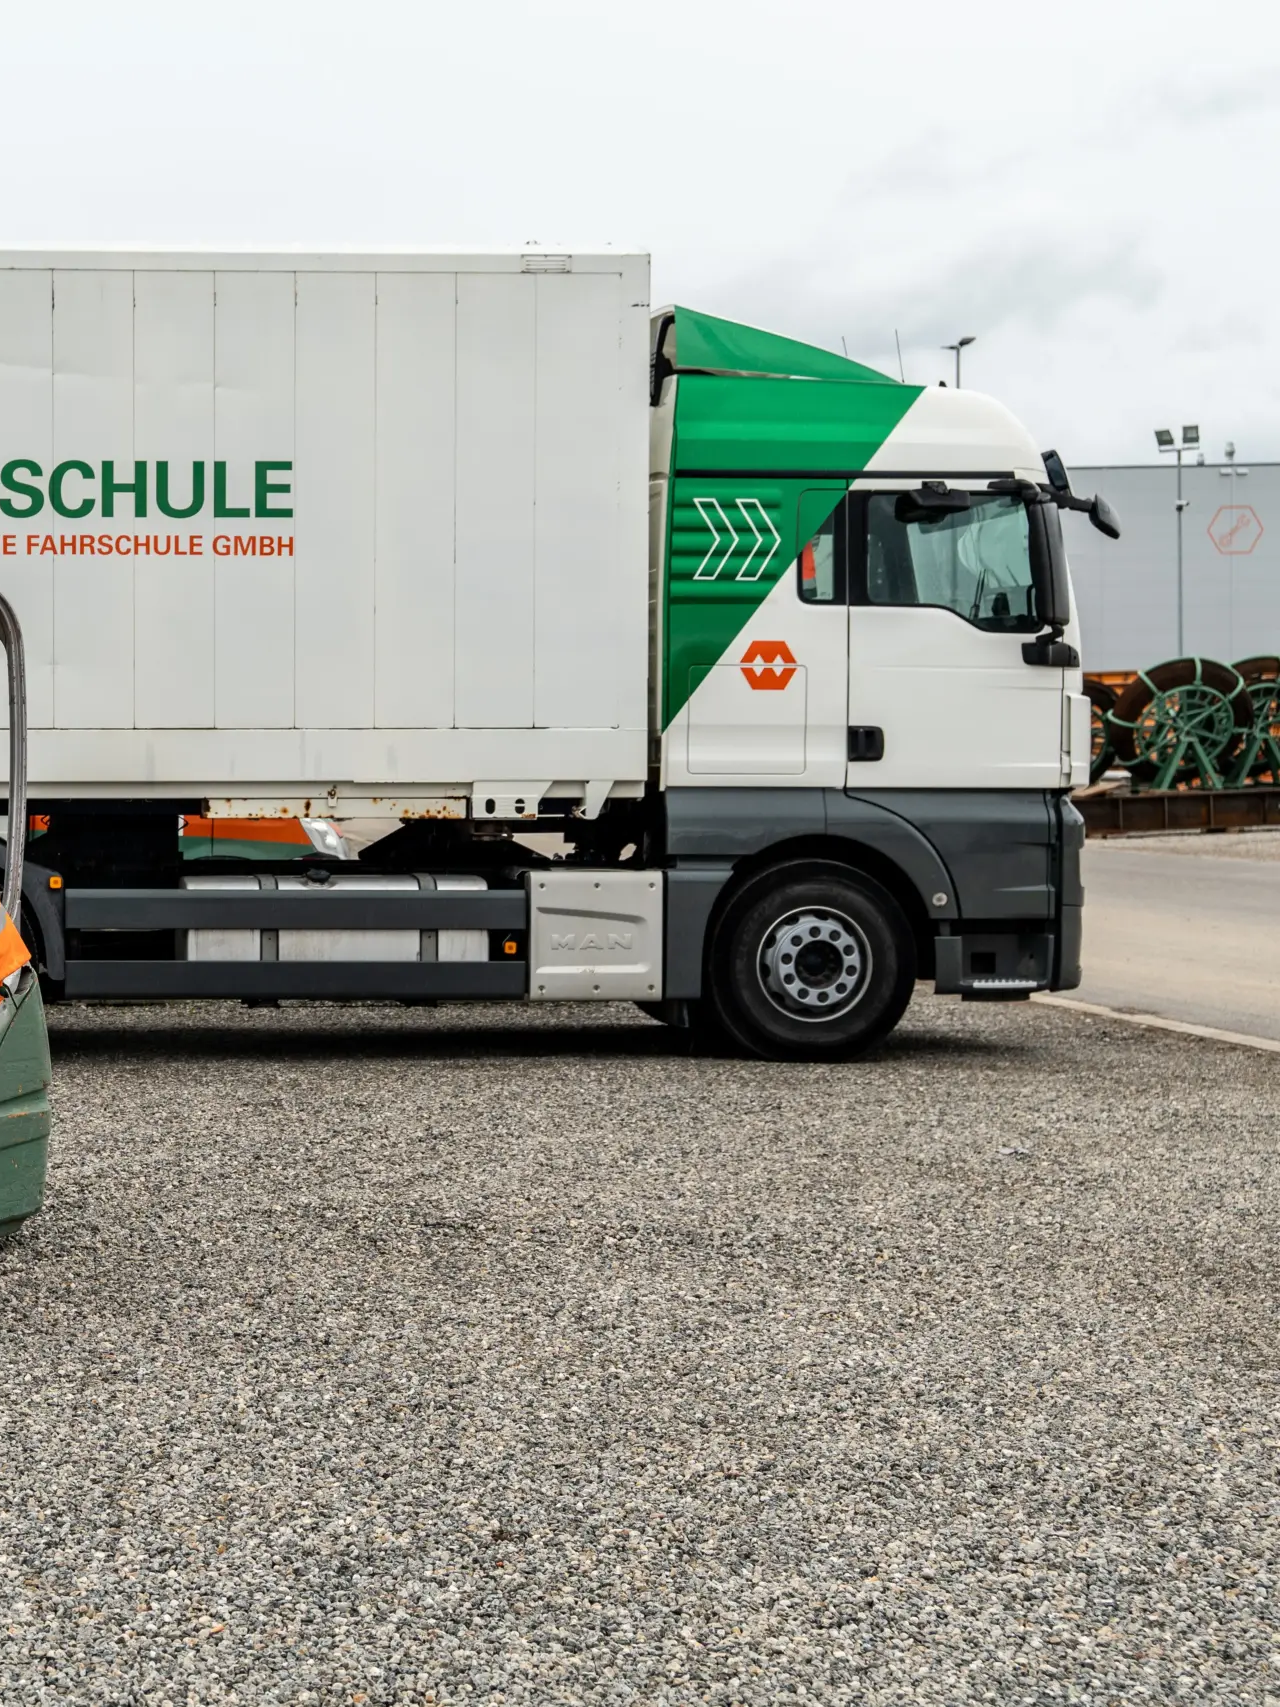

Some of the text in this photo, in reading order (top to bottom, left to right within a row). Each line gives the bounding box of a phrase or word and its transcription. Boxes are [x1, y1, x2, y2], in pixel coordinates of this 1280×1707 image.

[26, 533, 203, 556] FAHRSCHULE
[211, 534, 294, 556] GMBH
[550, 933, 633, 951] MAN
